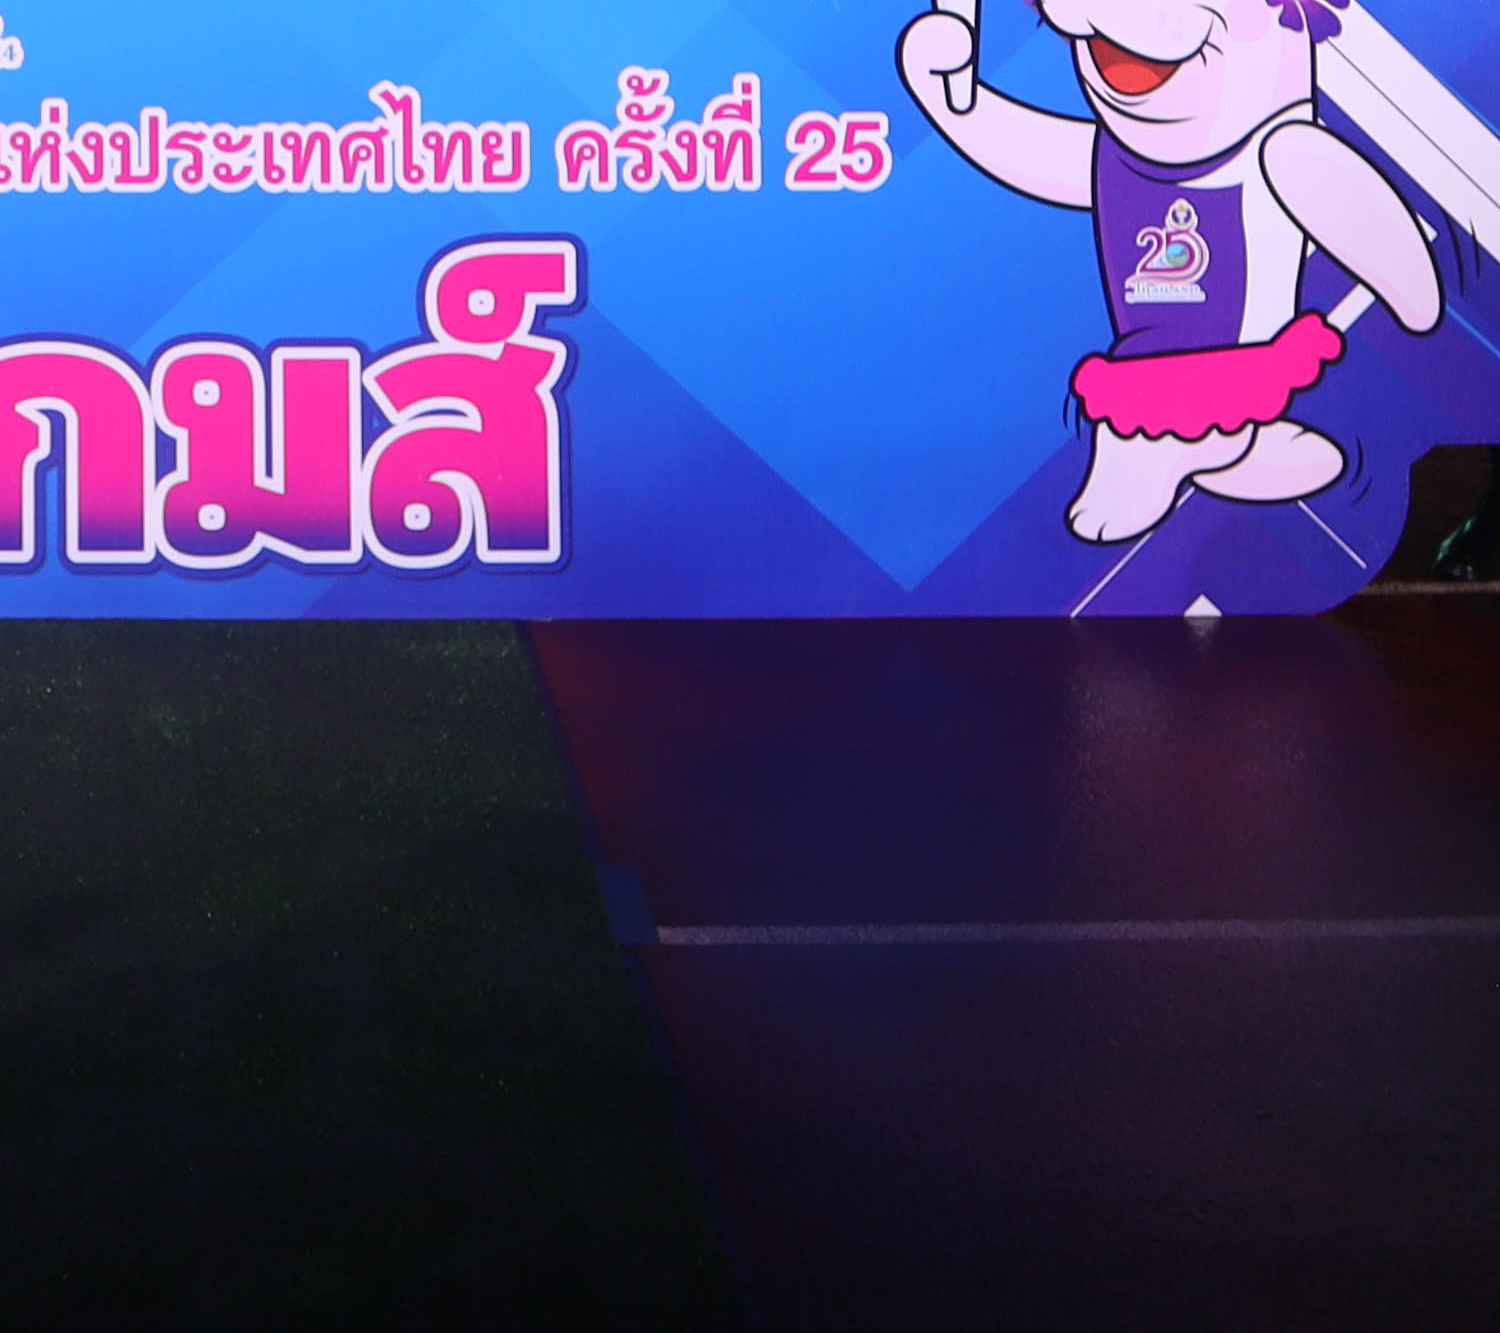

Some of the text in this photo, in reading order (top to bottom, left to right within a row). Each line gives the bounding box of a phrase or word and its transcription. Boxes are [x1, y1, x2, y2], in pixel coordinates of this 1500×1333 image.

[562, 74, 754, 184] ครั้งที่
[793, 120, 882, 183] 25
[1140, 230, 1196, 273] 25
